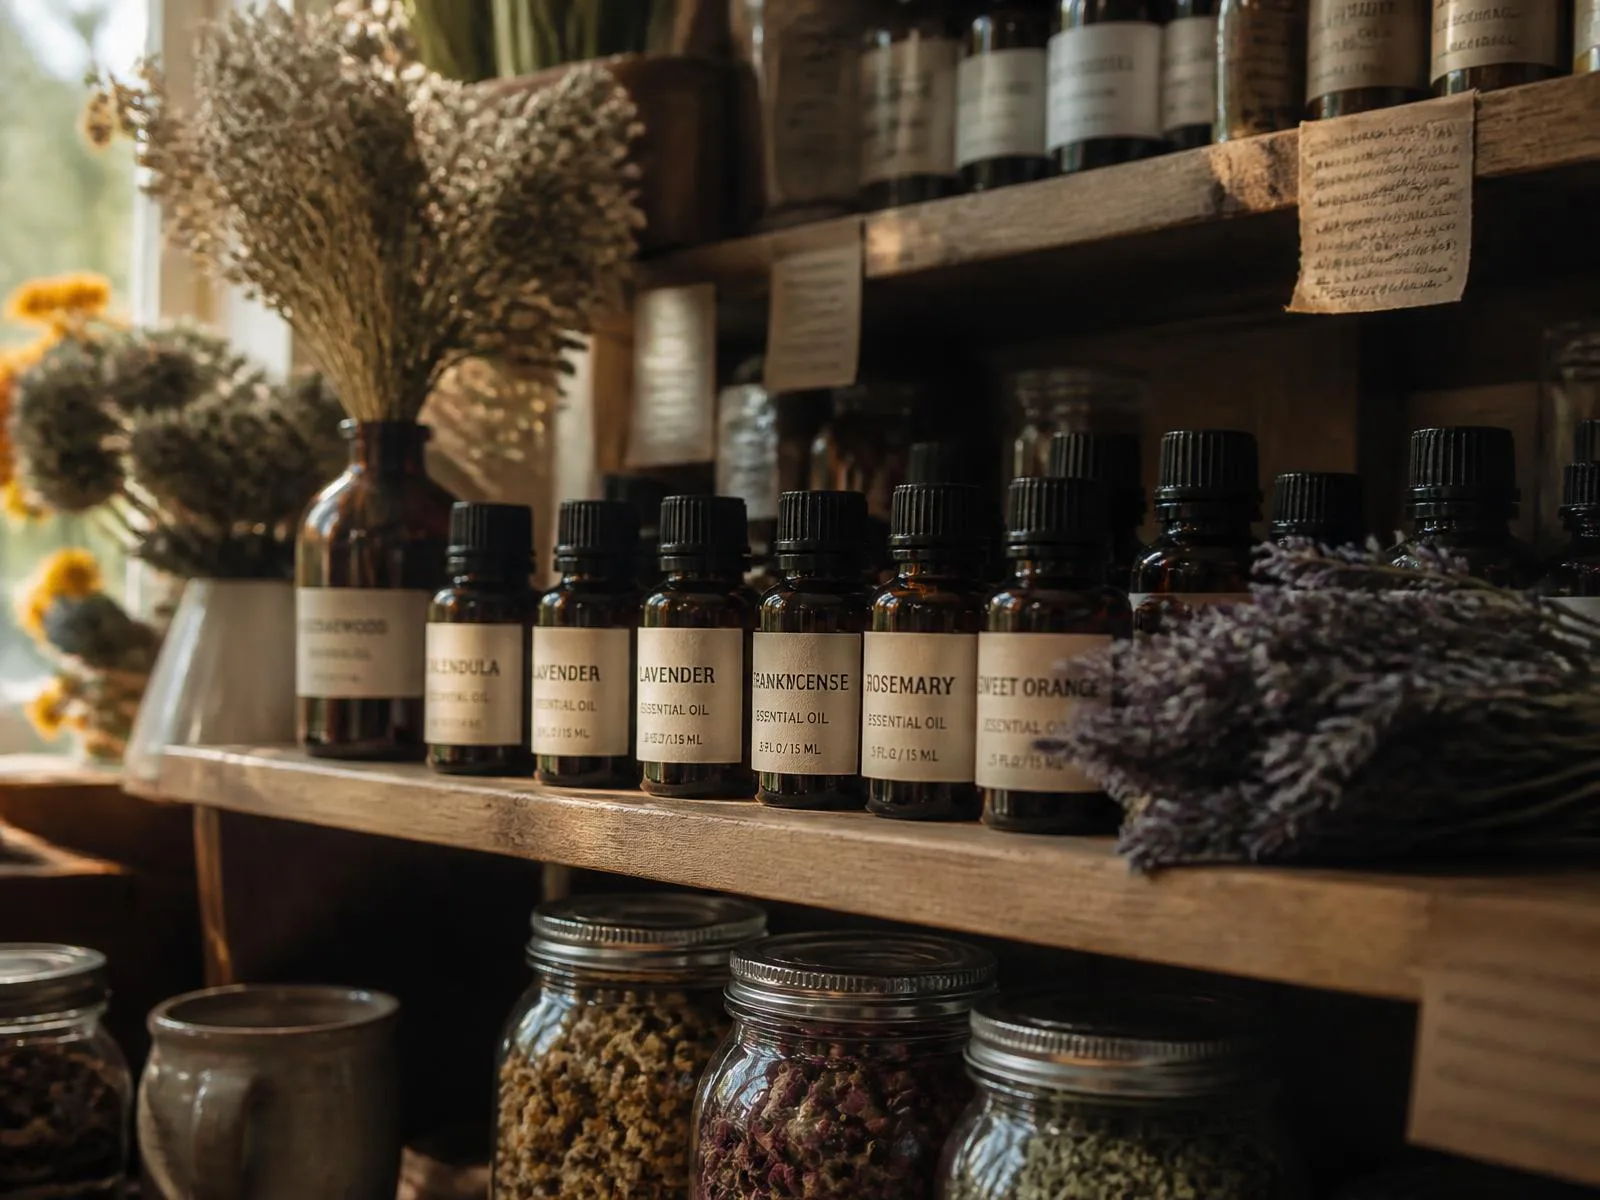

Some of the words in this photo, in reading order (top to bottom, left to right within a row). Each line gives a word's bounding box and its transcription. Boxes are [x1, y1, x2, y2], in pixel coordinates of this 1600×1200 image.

[639, 666, 715, 684] LAVENDER
[866, 674, 956, 695] ROSEMARY
[578, 700, 597, 712] OIL
[688, 704, 710, 716] OIL
[807, 712, 829, 724] OIL
[925, 716, 946, 730] OIL
[574, 728, 591, 740] ML
[686, 734, 703, 746] ML
[804, 743, 822, 755] ML
[920, 749, 939, 762] ML
